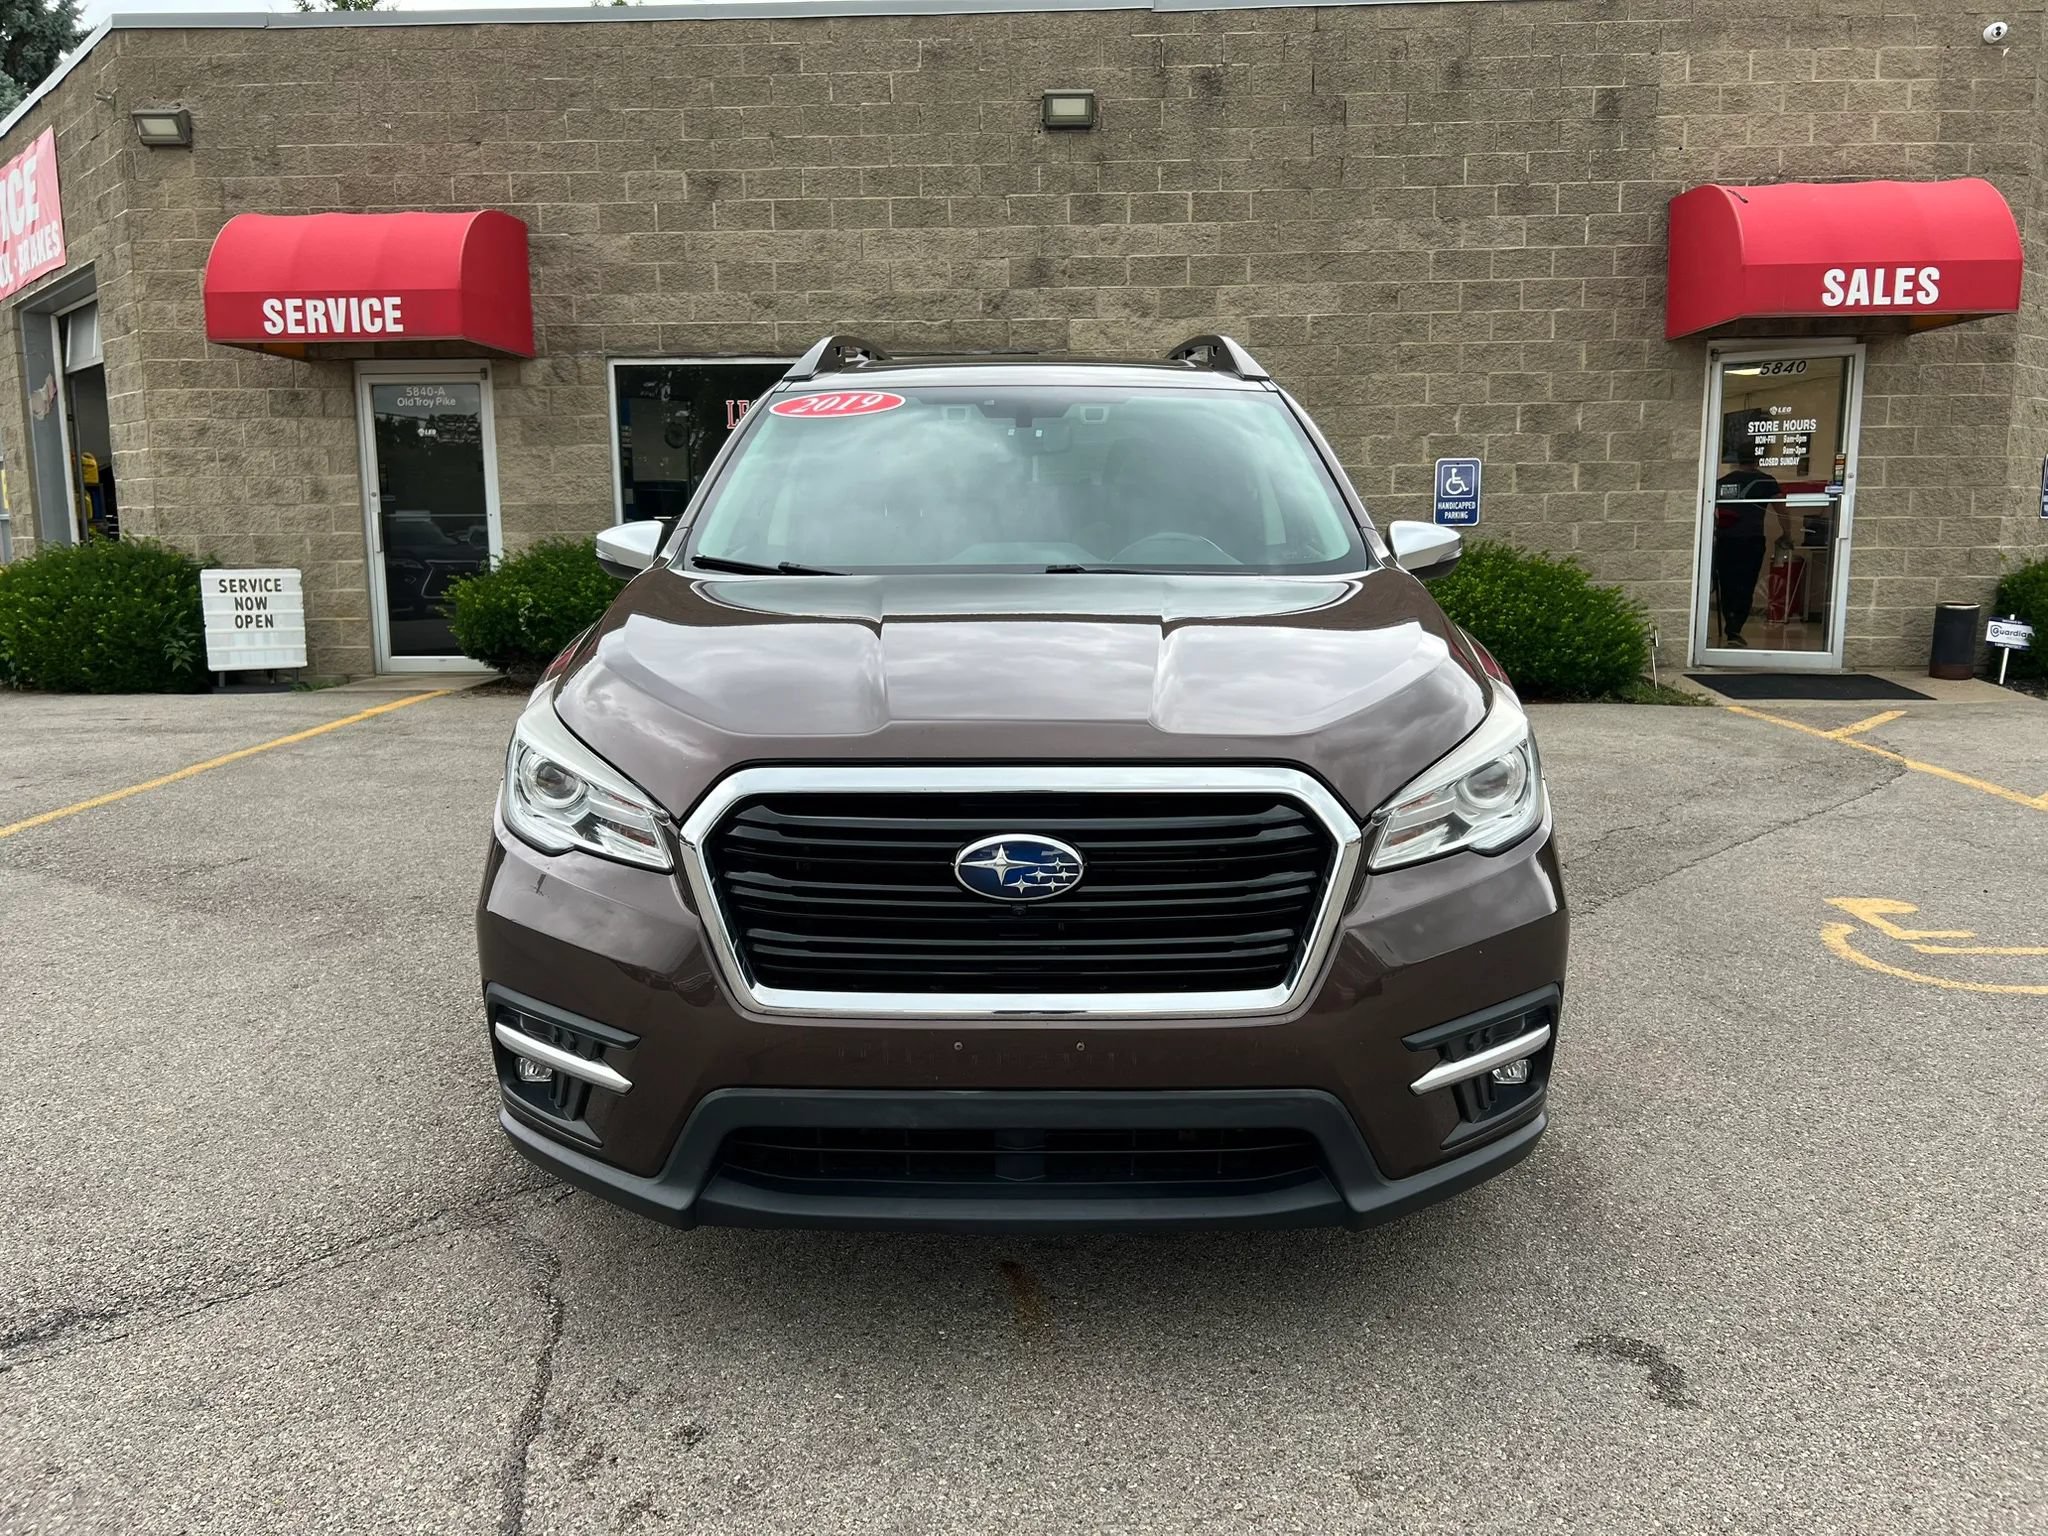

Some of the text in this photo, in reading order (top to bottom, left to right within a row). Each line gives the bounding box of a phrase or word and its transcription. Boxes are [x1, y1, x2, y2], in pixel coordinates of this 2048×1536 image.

[1821, 267, 1940, 307] SALES
[262, 296, 404, 335] SERVICE
[1760, 360, 1807, 376] 5840
[406, 386, 446, 397] 5840-A
[397, 397, 457, 408] Old Troy Pike
[788, 394, 884, 414] 2019
[1747, 418, 1817, 433] STORE HOURS
[1754, 435, 1777, 444] MON-FRI
[1754, 446, 1765, 456] SAT
[1759, 456, 1800, 467] CLOSED SUNDAY
[1437, 501, 1476, 510] HANDICAPPED
[1444, 511, 1469, 519] PARKING
[218, 578, 283, 593] SERVICE
[234, 596, 267, 611] NOW
[235, 614, 274, 629] OPEN
